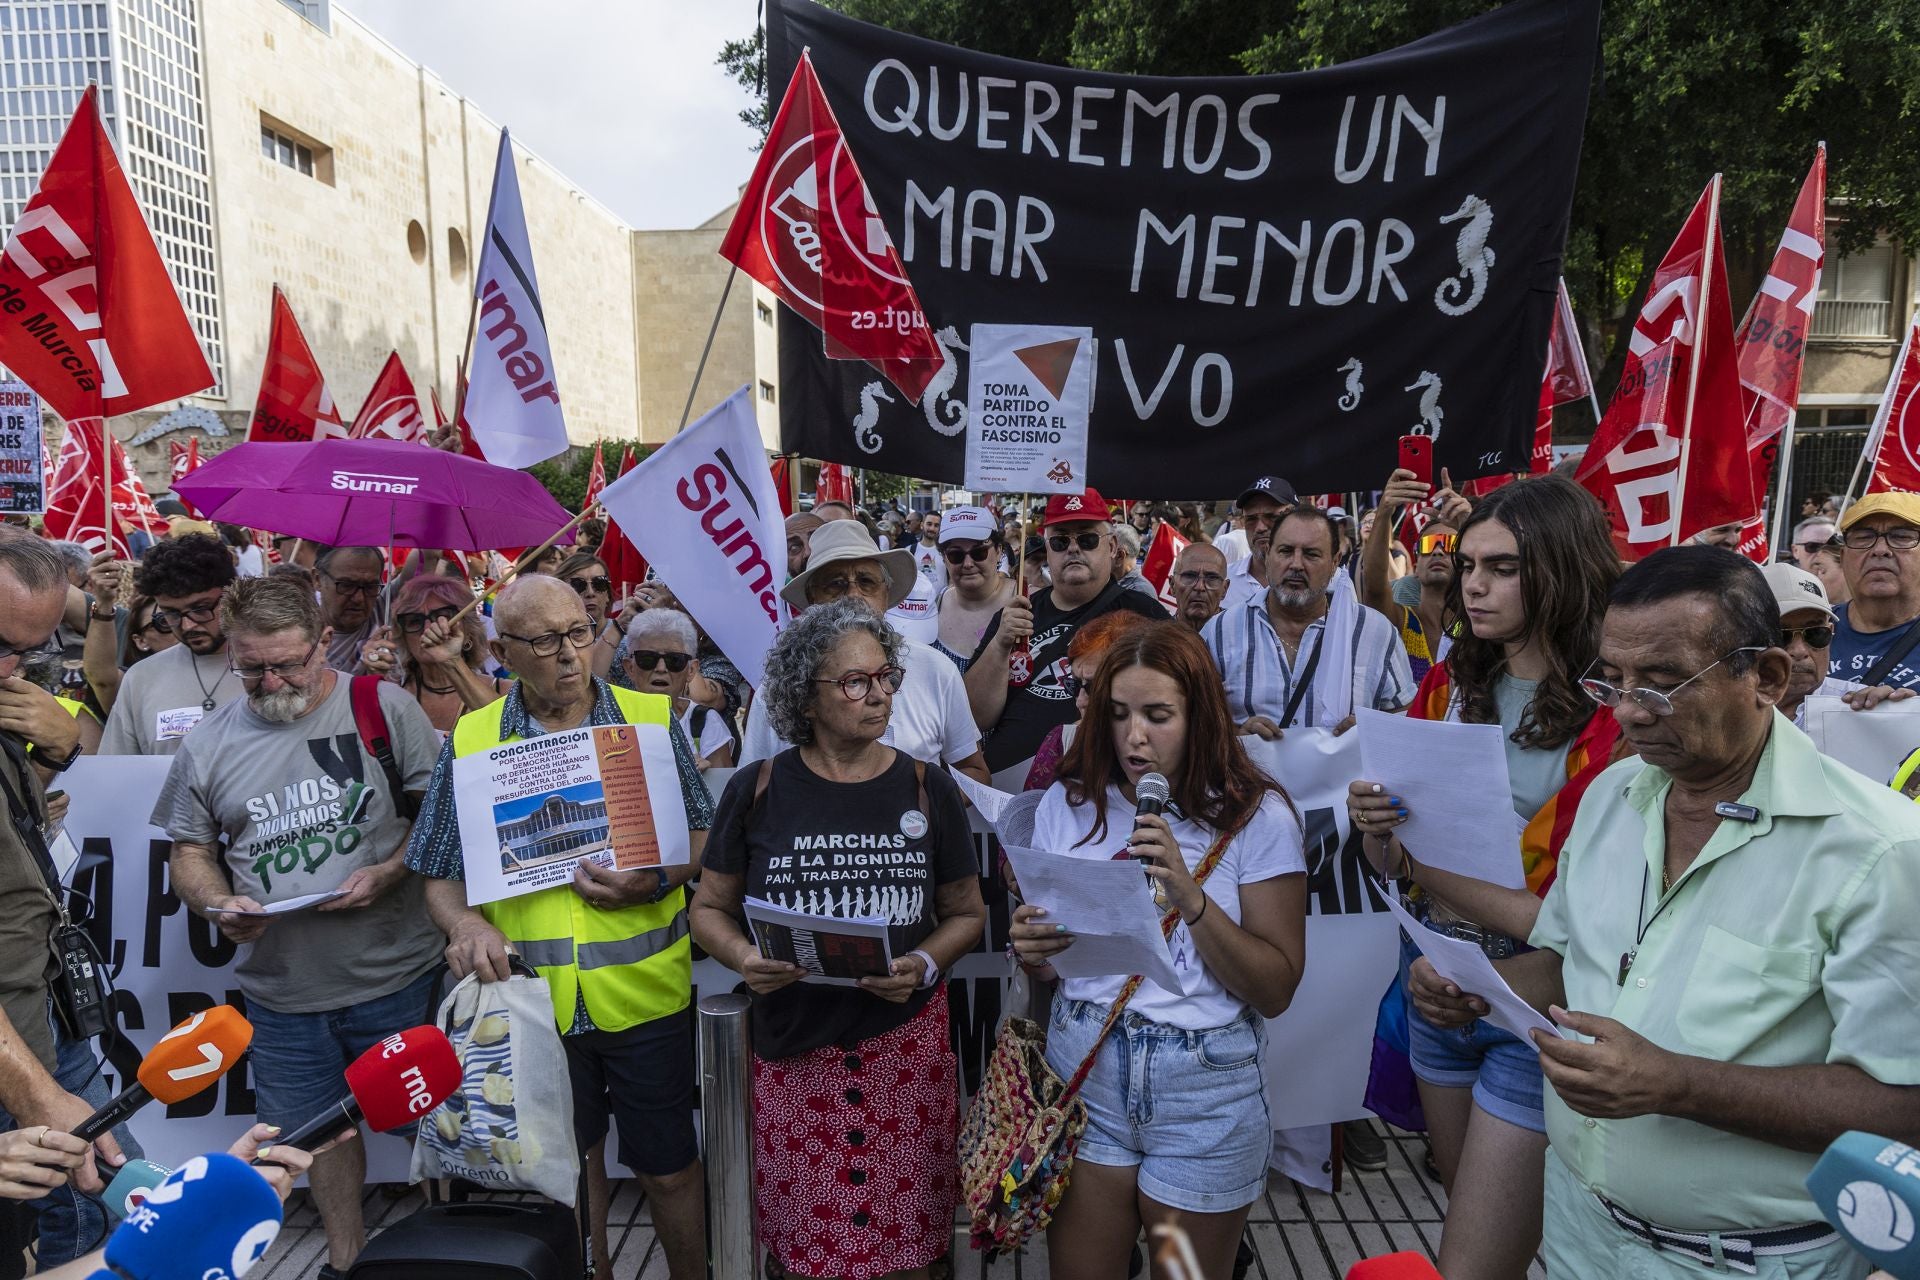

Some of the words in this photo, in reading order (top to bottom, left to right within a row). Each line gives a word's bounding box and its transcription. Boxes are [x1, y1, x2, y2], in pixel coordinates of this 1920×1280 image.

[864, 57, 1280, 181] QUEREMOS
[1335, 94, 1447, 185] UN
[903, 179, 1055, 283] MAR
[1130, 208, 1414, 308] MENOR
[0, 282, 26, 315] de
[20, 312, 97, 394] Murcia
[984, 383, 1030, 397] TOMA
[983, 398, 1050, 413] PARTIDO
[7, 415, 25, 431] DE
[982, 414, 1048, 428] CONTRA
[1051, 416, 1067, 429] EL
[981, 430, 1062, 444] FASCISMO
[331, 474, 418, 495] Sumar
[1049, 475, 1071, 485] PCE
[949, 513, 978, 522] Sumar
[897, 602, 929, 612] Sumar
[1029, 626, 1060, 647] LOVE
[1029, 685, 1055, 698] HATE
[602, 727, 627, 743] MHC
[490, 731, 589, 760] CONCENTRACIÓN
[499, 757, 515, 766] POR
[517, 755, 527, 764] LA
[528, 743, 578, 760] CONVIVENCIA
[492, 773, 507, 782] LOS
[509, 765, 550, 777] DERECHOS
[553, 755, 590, 767] HUMANOS
[512, 752, 567, 770] DEMOCRÁTICA
[508, 777, 518, 785] DE
[521, 773, 531, 782] LA
[532, 764, 583, 780] NATURALEZA.
[519, 776, 552, 789] CONTRA
[552, 773, 567, 781] LOS
[246, 792, 280, 822] SI
[284, 774, 341, 811] NOS
[495, 782, 554, 803] PRESUPUESTOS
[557, 779, 572, 787] DEL
[256, 801, 343, 838] MOVEMOS
[249, 820, 337, 857] CAMBIAMOS
[794, 834, 906, 850] MARCHAS
[251, 826, 362, 894] TODO
[548, 860, 577, 872] REGIONAL
[768, 856, 793, 869] DE
[800, 854, 825, 867] LA
[833, 851, 926, 866] DIGNIDAD
[531, 874, 567, 887] CARTAGENA
[766, 873, 795, 885] PAN,
[802, 869, 869, 882] TRABAJO
[874, 869, 884, 878] Y
[888, 868, 927, 879] TECHO
[400, 1065, 433, 1114] rne
[124, 1205, 160, 1234] OPE
